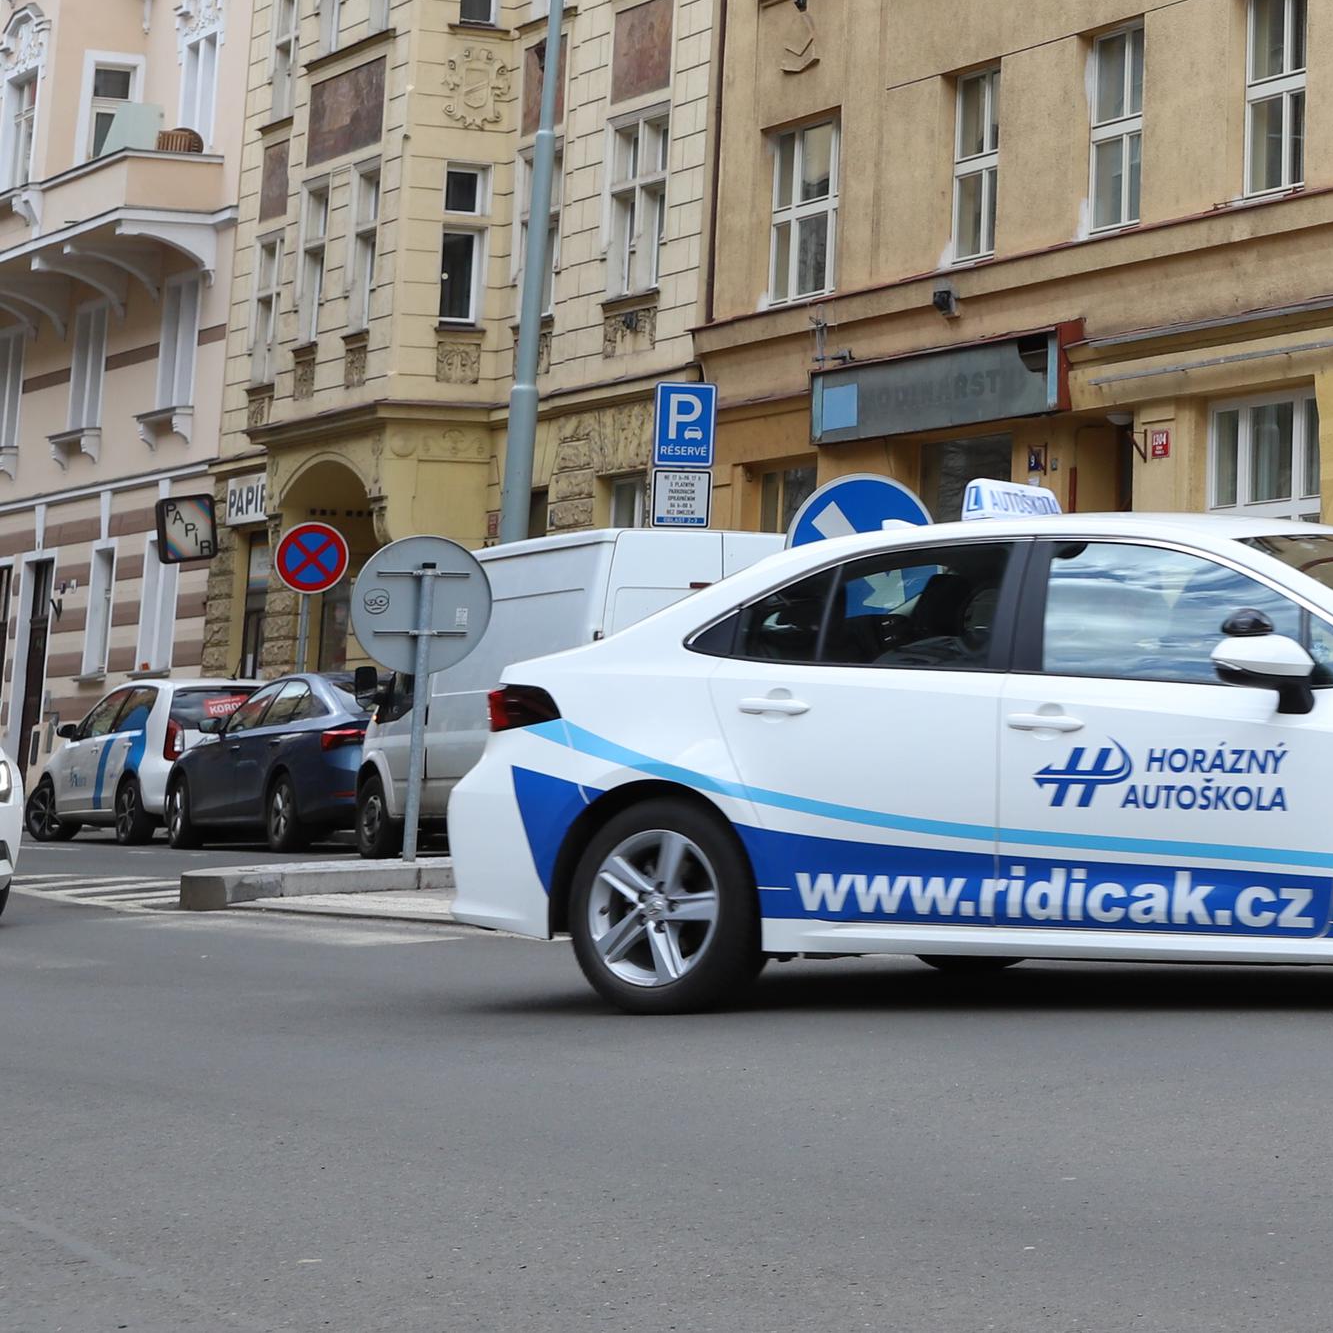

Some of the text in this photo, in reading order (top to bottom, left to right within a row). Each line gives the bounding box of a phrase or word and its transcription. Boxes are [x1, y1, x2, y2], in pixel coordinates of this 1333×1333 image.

[668, 393, 703, 440] P
[660, 443, 708, 456] RÉSERVÉ
[165, 502, 212, 555] PAPÍR
[1146, 741, 1288, 774] HORÁZNÝ
[1120, 778, 1288, 811] AUTOŠKOLA
[796, 865, 1315, 929] www.ridicak.cz
